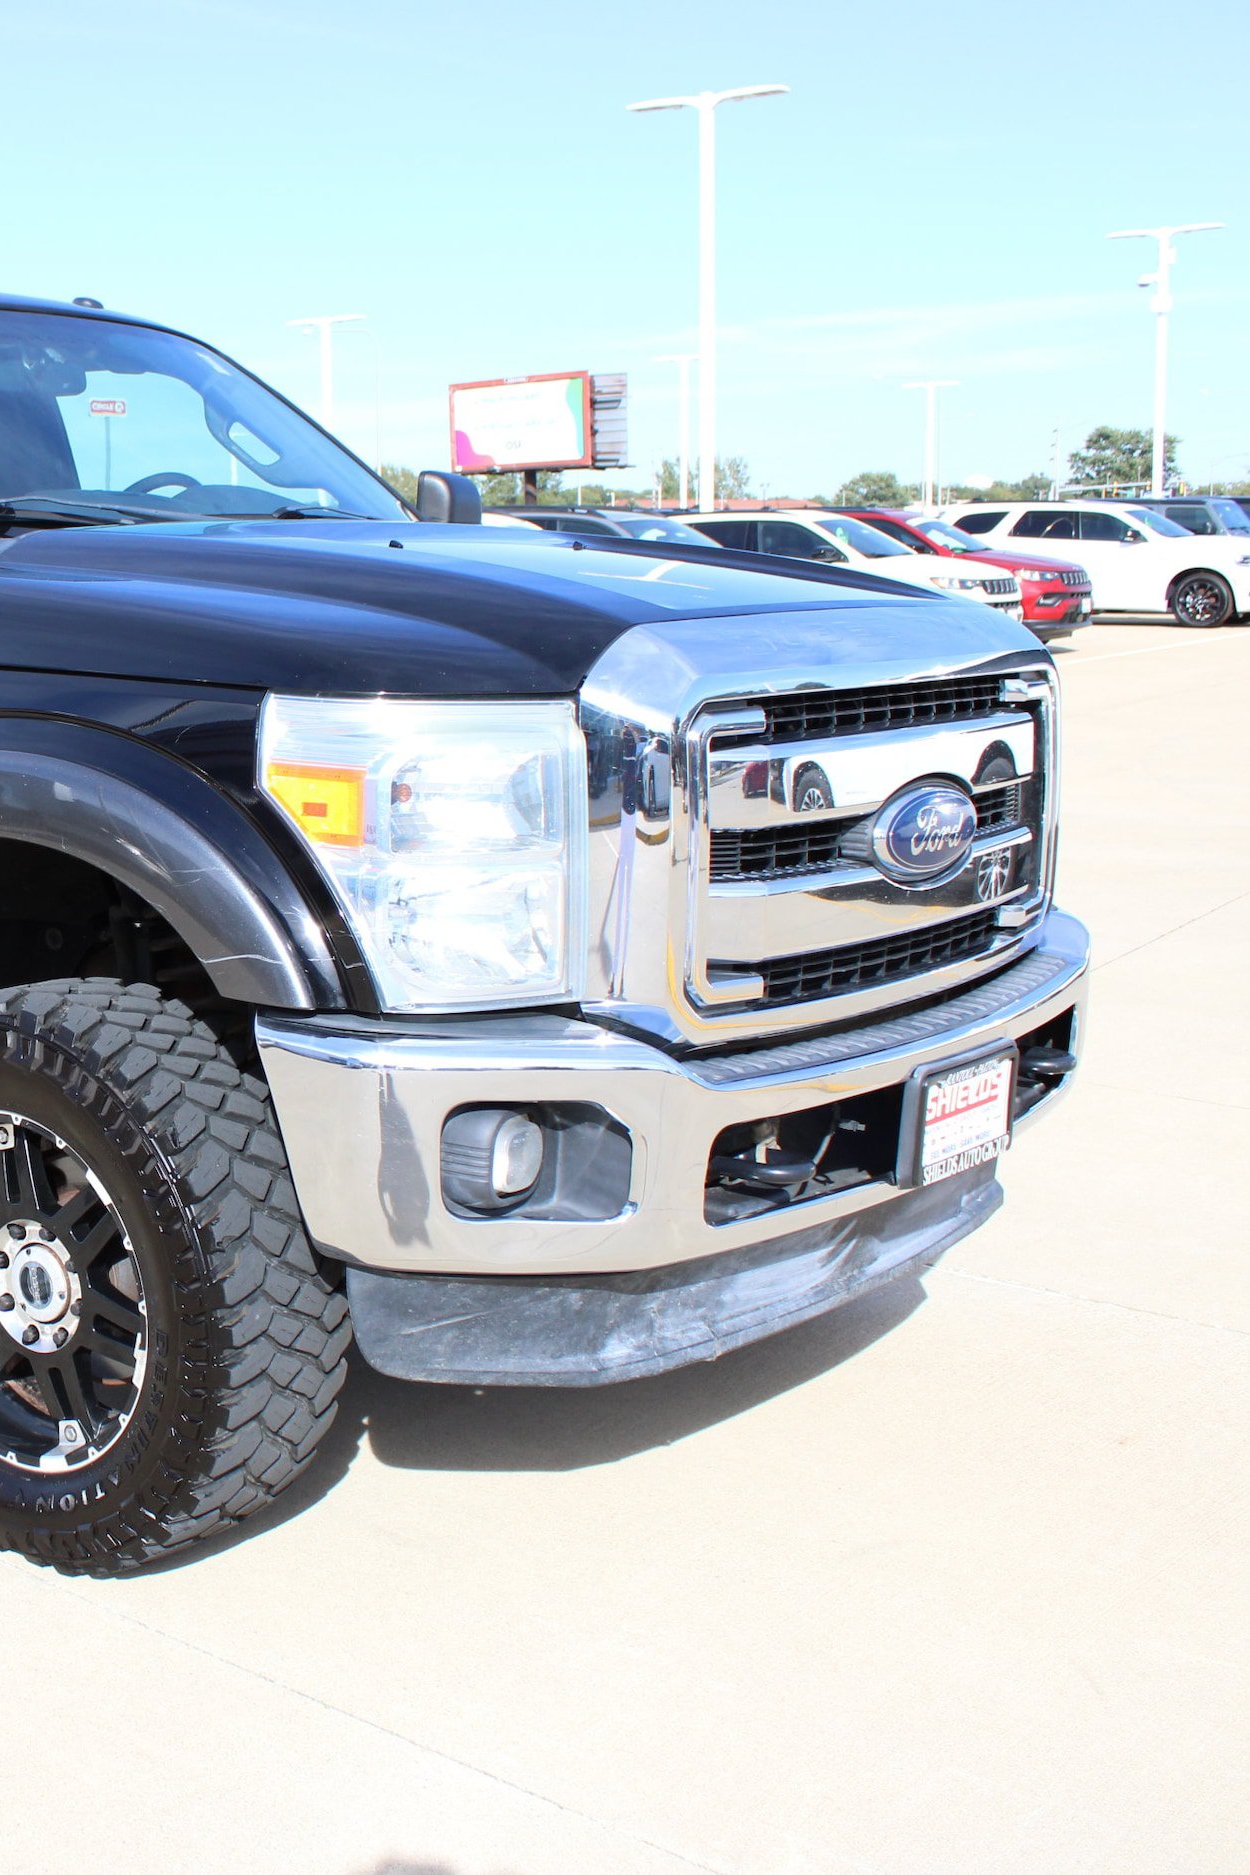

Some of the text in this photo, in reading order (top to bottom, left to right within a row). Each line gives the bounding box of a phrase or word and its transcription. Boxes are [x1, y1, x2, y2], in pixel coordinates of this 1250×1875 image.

[910, 805, 964, 856] Ford
[926, 1071, 1004, 1122] SHIELDS
[922, 1153, 958, 1186] SHIELDS
[958, 1142, 983, 1173] AUTO
